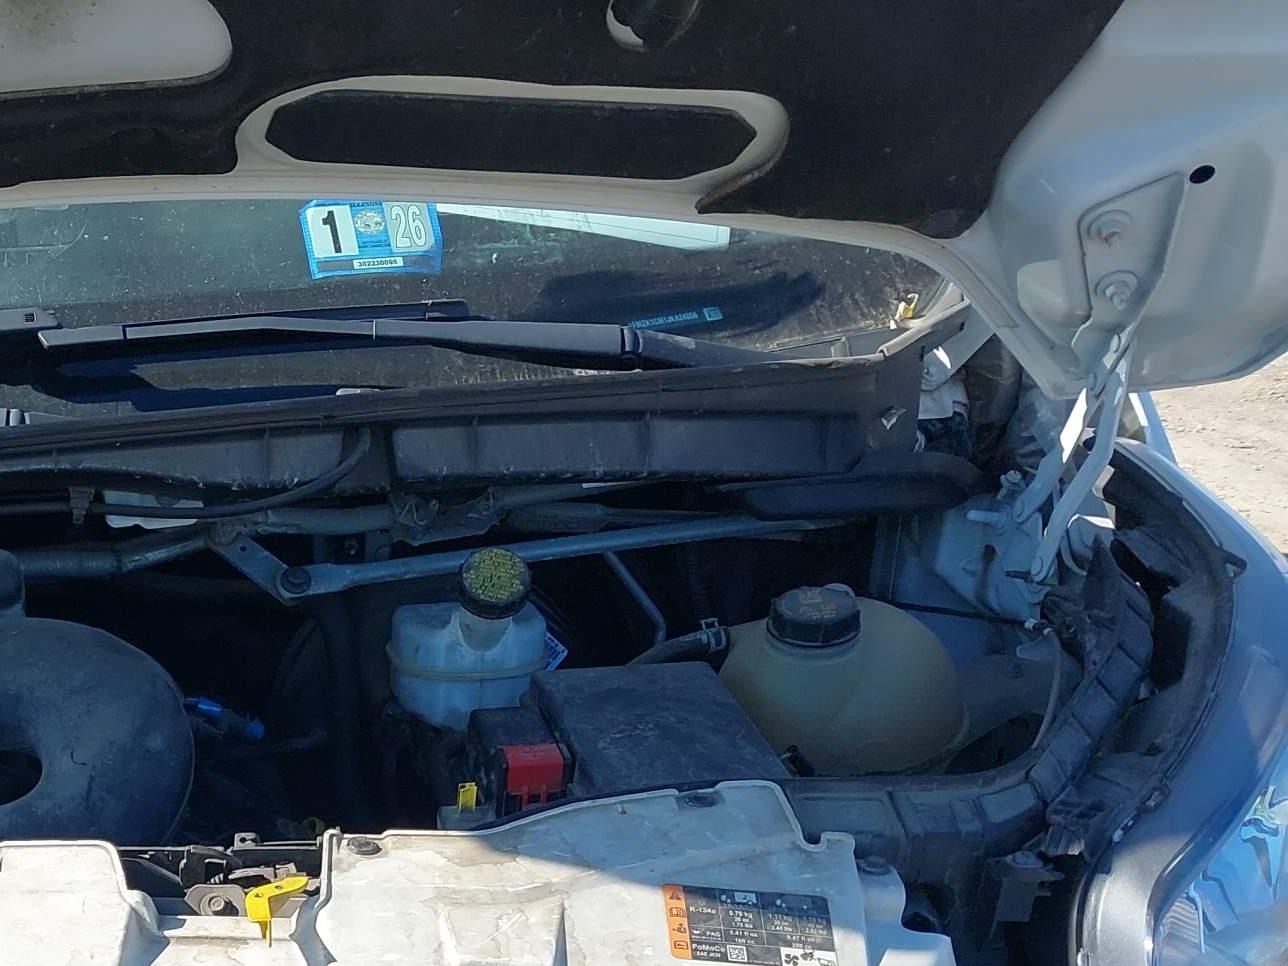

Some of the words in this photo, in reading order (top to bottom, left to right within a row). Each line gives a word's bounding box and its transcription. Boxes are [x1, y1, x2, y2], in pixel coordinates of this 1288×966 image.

[322, 210, 343, 253] 1
[390, 204, 427, 248] 26
[692, 943, 726, 952] FoMoCo
